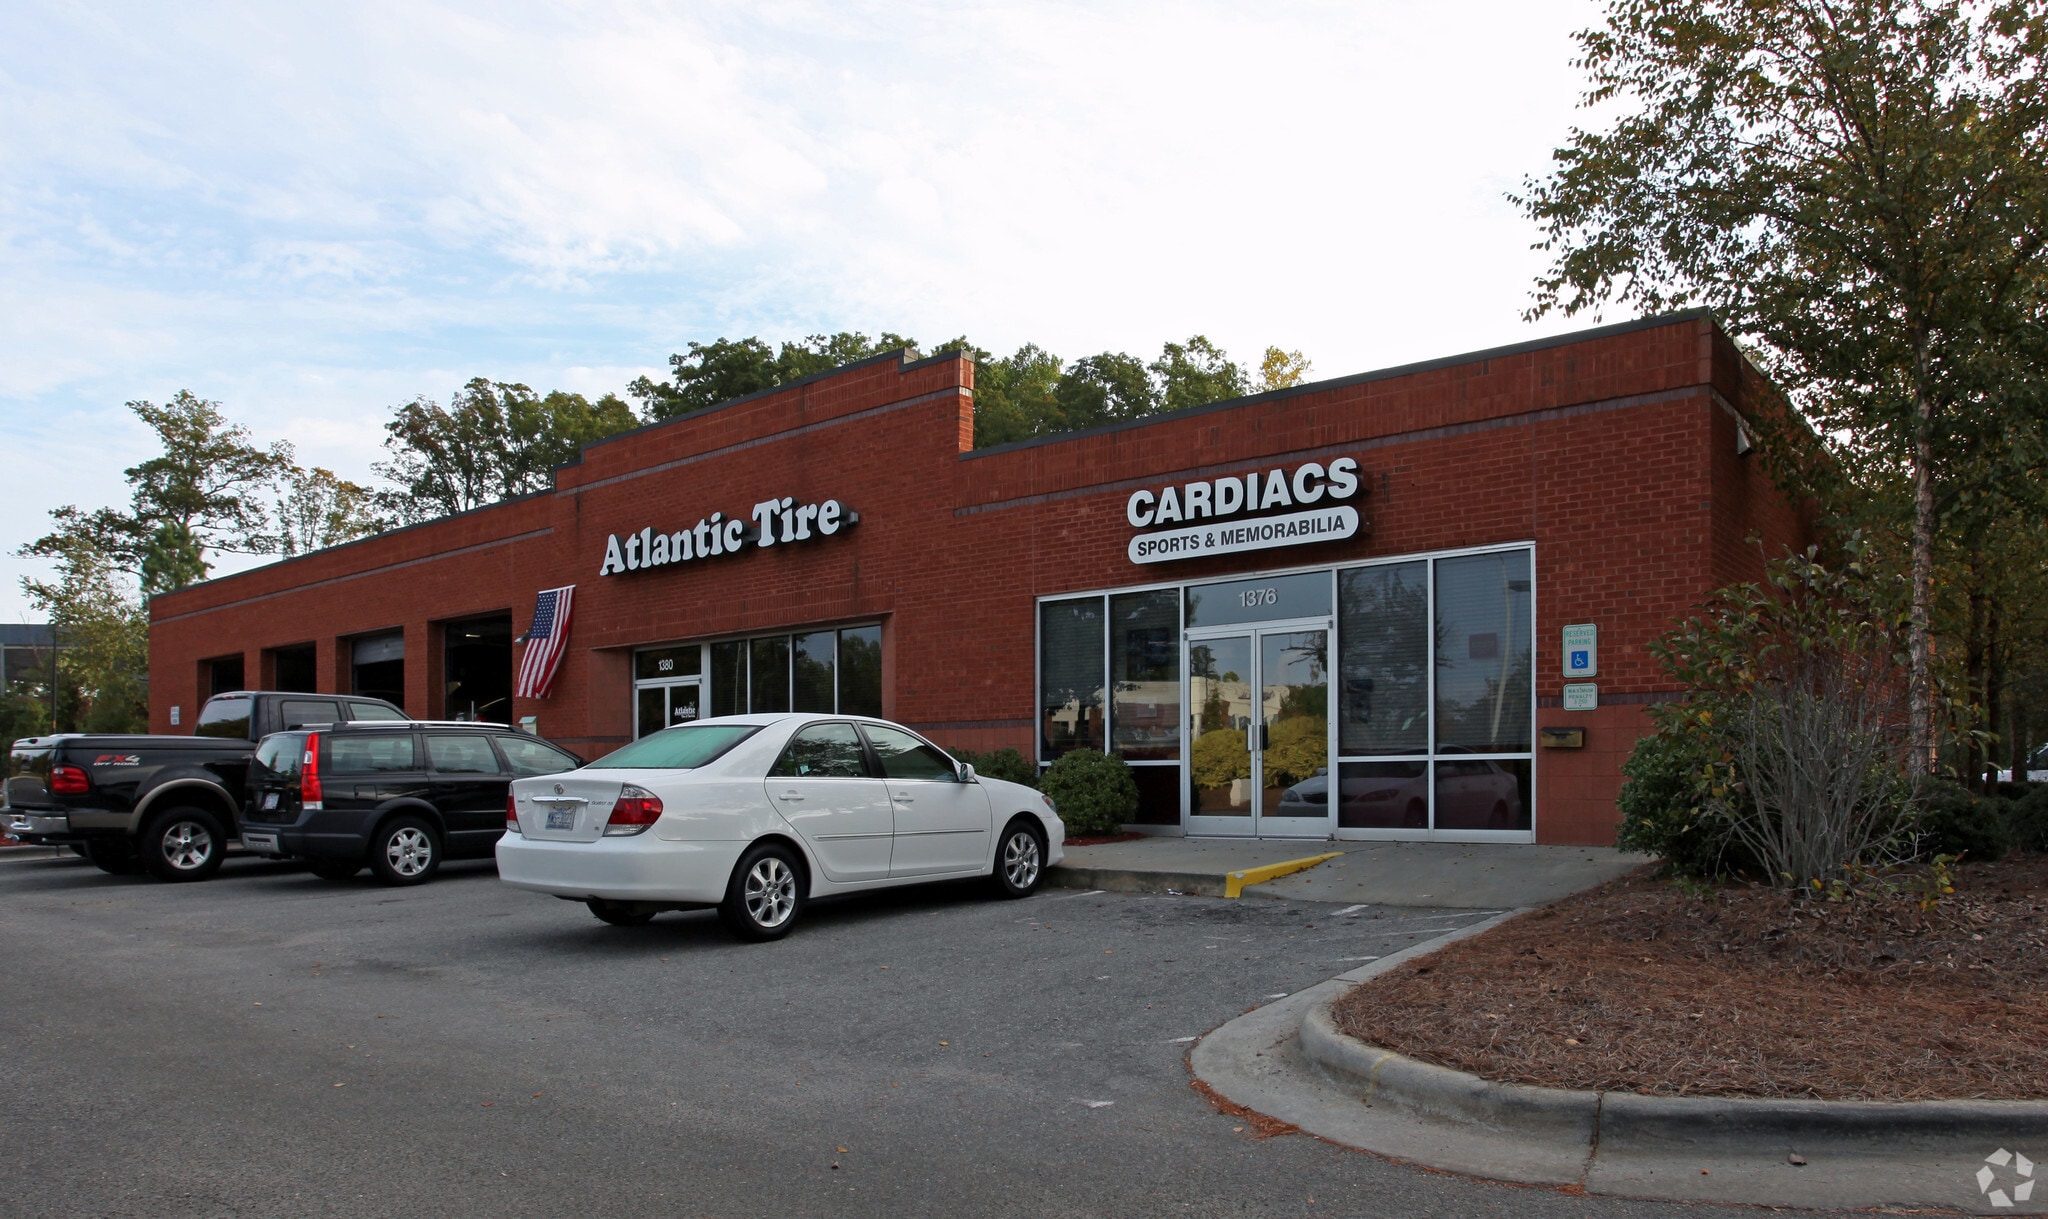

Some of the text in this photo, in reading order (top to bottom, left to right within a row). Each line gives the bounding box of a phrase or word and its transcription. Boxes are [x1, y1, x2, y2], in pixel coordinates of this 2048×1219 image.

[1127, 457, 1359, 528] CARDIACS
[599, 496, 841, 576] Atlantic Tire
[1137, 515, 1346, 556] SPORTS & MEMORABILIA
[1238, 588, 1278, 608] 1376
[1565, 629, 1594, 638] RESERVED
[658, 659, 673, 671] 1380
[95, 754, 141, 763] FX4
